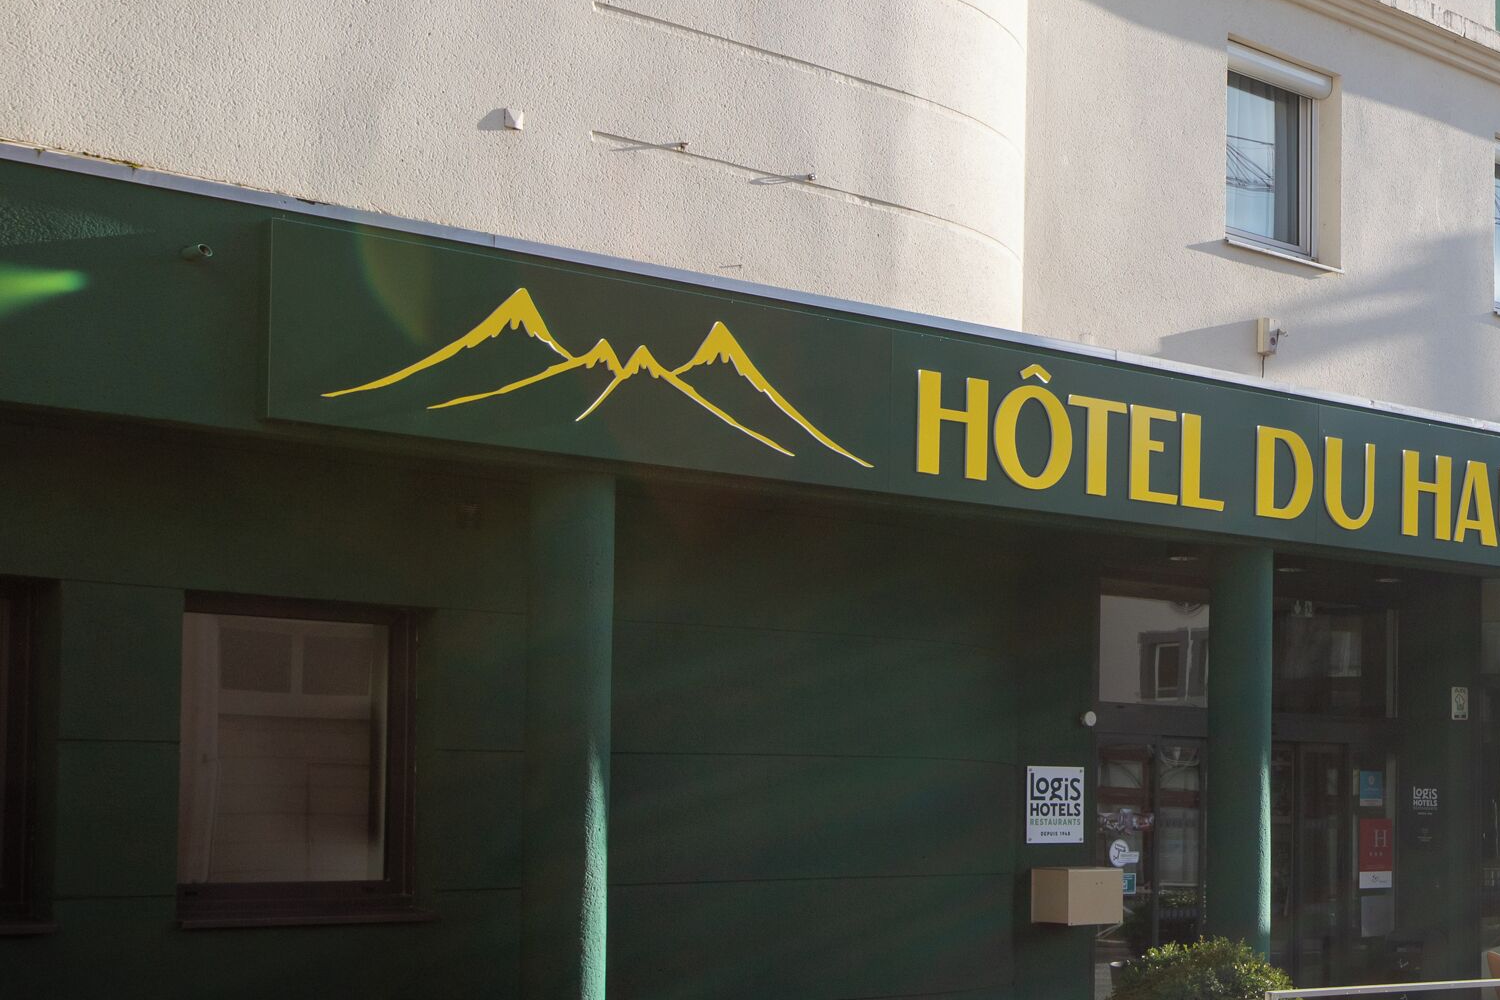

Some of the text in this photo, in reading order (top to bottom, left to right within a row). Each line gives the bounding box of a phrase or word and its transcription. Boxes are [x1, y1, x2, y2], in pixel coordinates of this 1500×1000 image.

[916, 363, 1225, 512] HÔTEL
[1255, 424, 1376, 530] DU
[1029, 803, 1081, 817] HOTELS
[1412, 799, 1438, 807] HOTELS
[1029, 818, 1081, 826] RESTAURANTS
[1374, 829, 1388, 848] H
